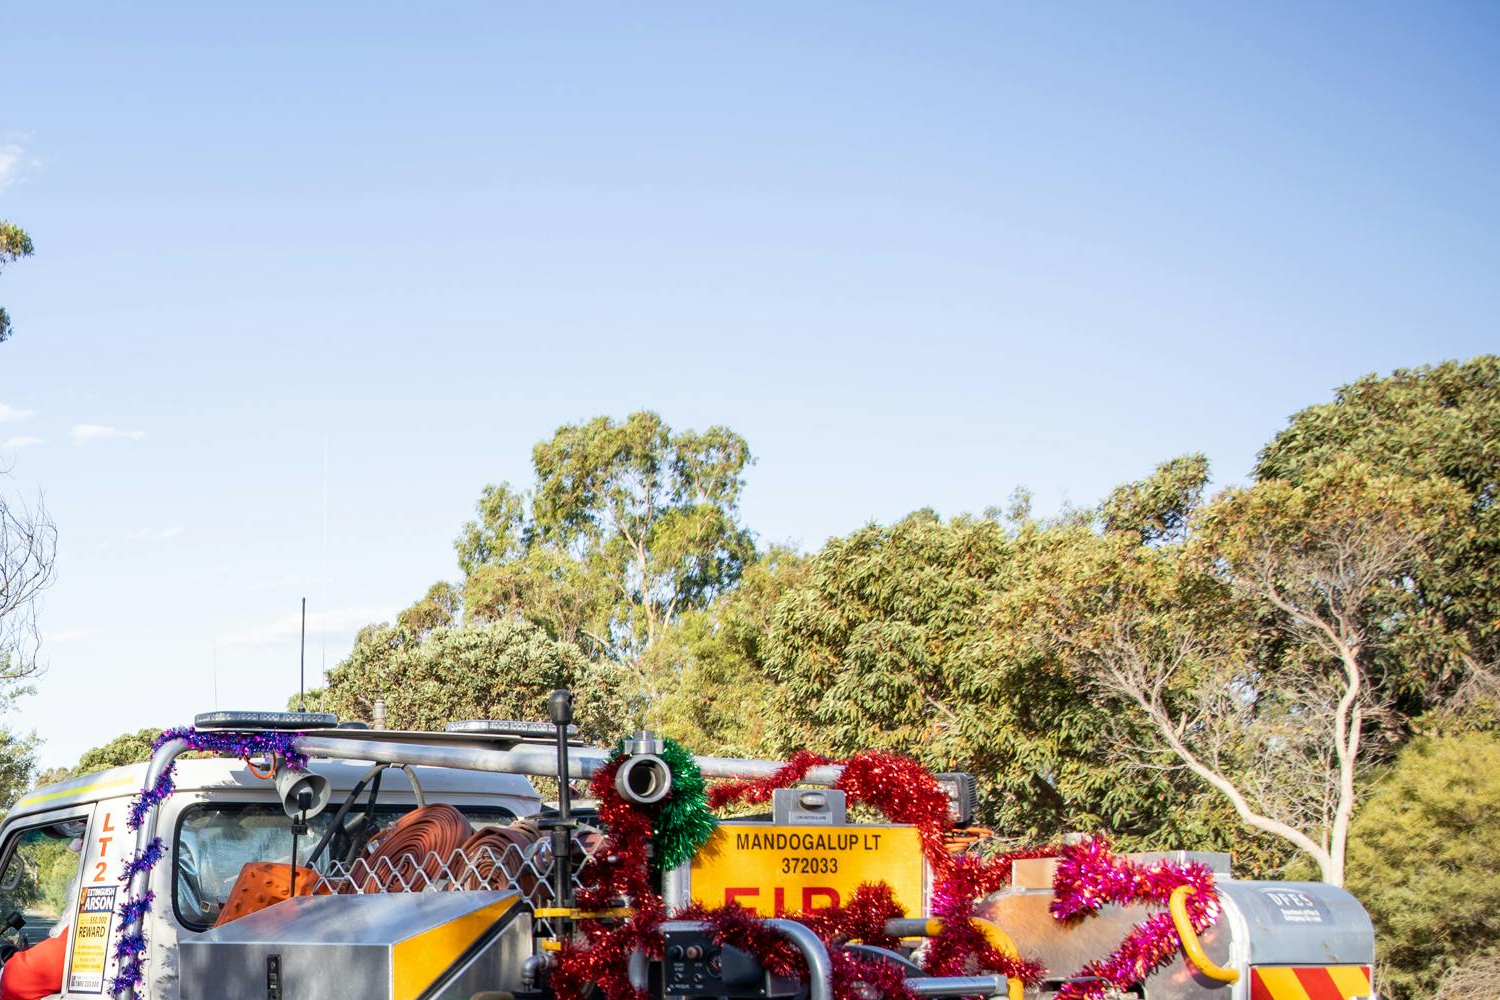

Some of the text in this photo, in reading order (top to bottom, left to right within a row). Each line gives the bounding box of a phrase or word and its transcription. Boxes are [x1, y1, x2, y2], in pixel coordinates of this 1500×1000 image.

[736, 833, 882, 851] MANDOGALUP LT
[782, 857, 839, 874] 372033
[84, 896, 114, 911] ARSON
[1267, 892, 1314, 907] DFES
[79, 926, 106, 938] REWARD
